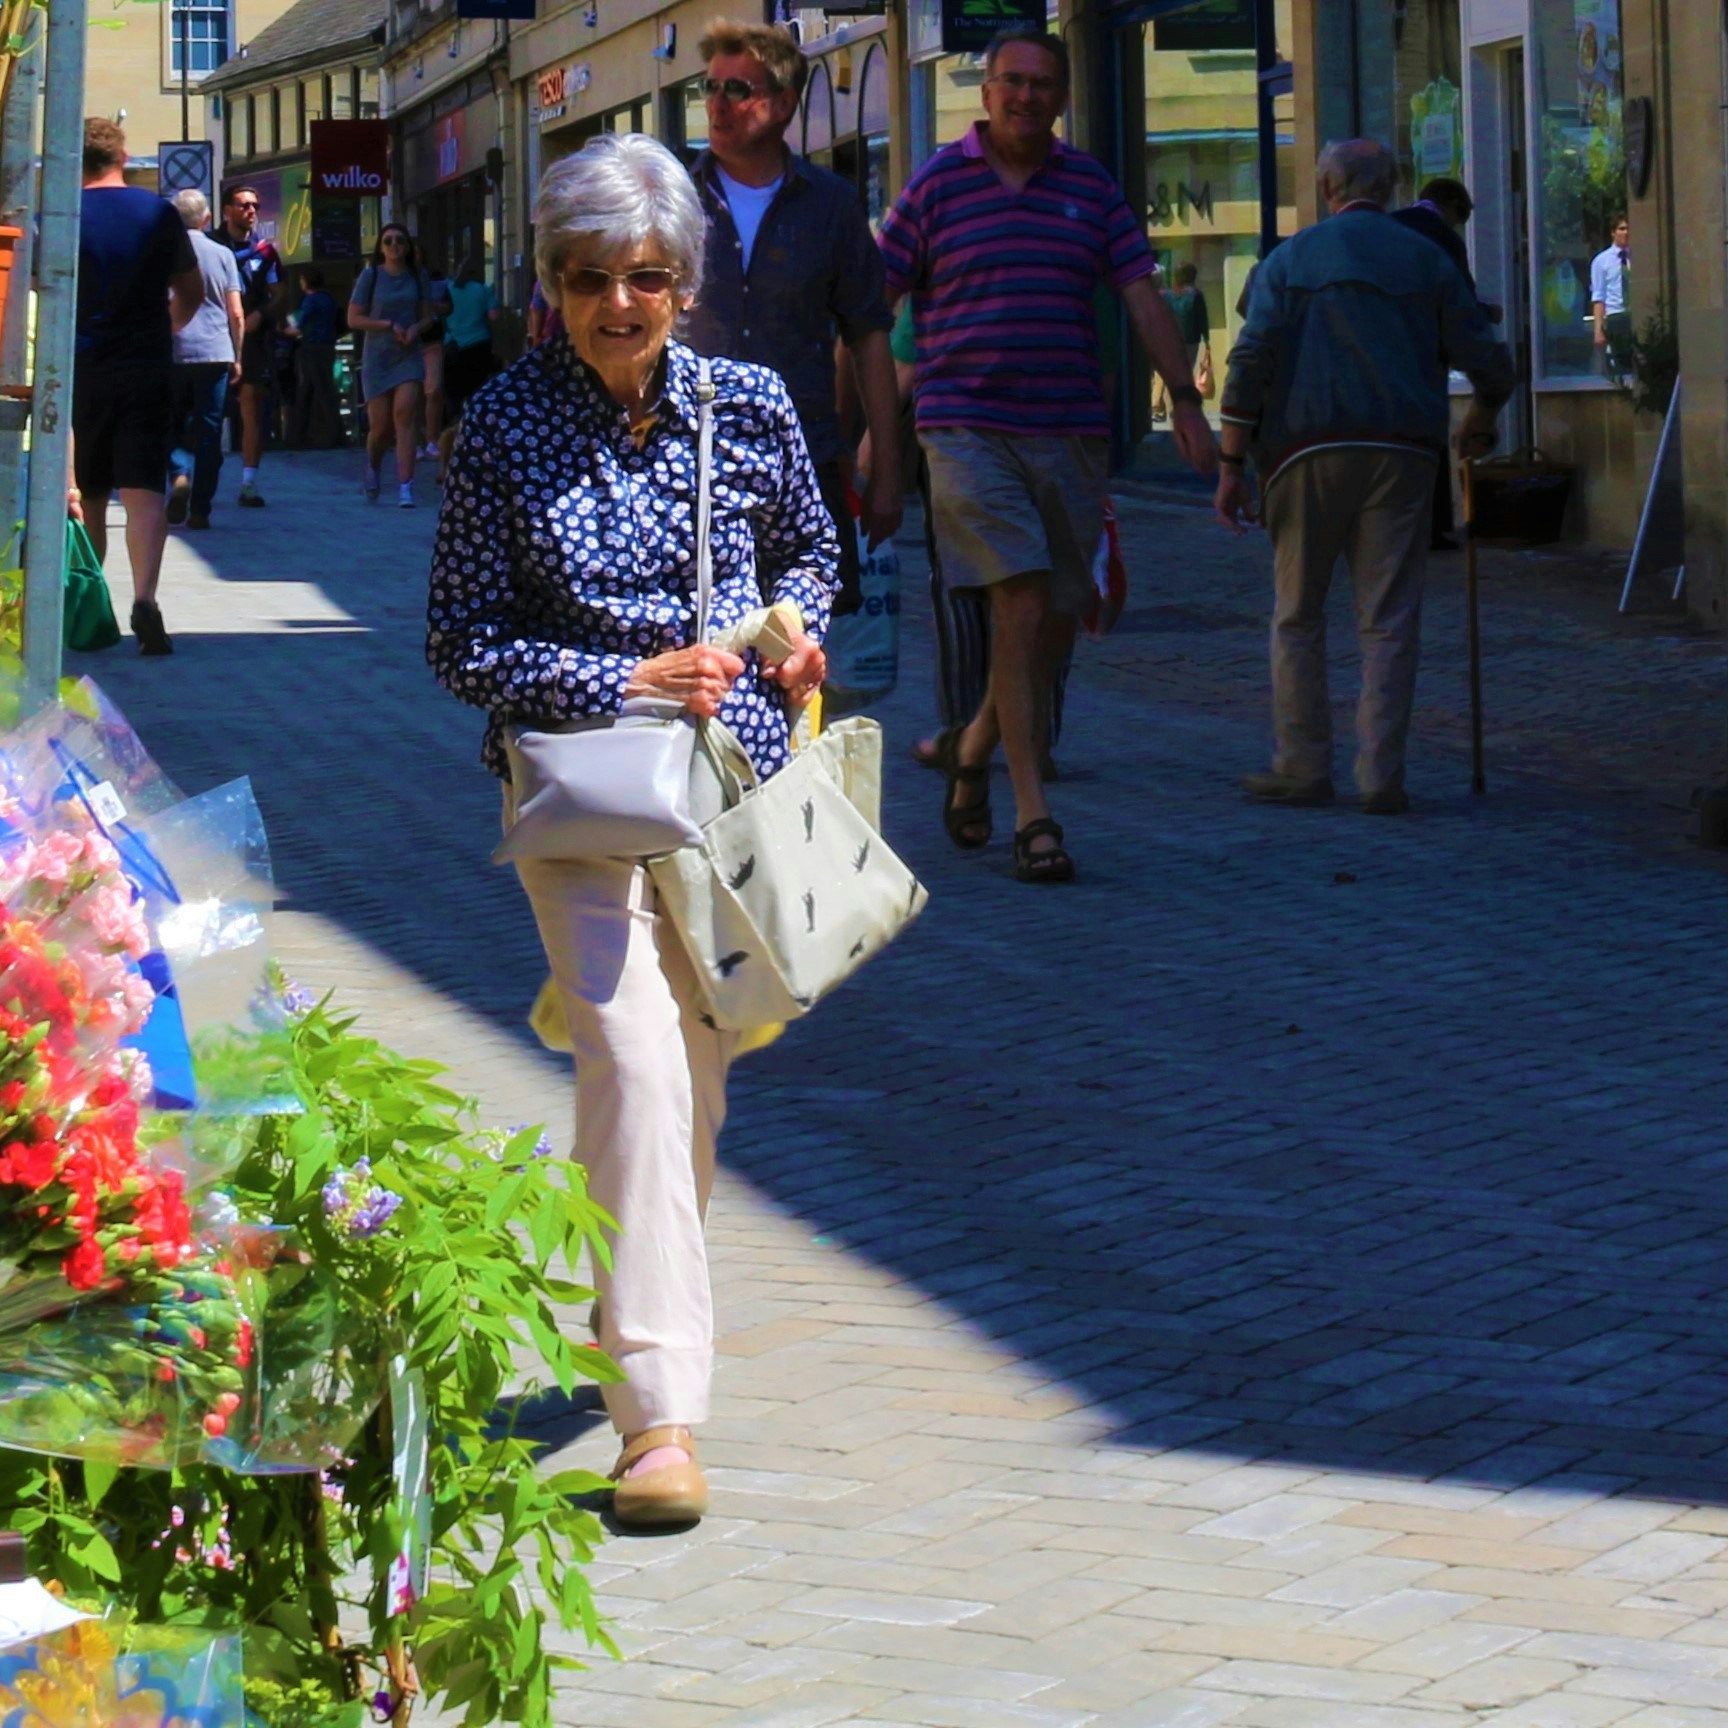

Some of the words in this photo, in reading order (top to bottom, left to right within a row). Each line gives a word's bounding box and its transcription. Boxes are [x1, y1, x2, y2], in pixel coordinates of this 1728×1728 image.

[952, 16, 972, 27] The
[538, 68, 564, 107] TESCO
[321, 164, 381, 189] wilko
